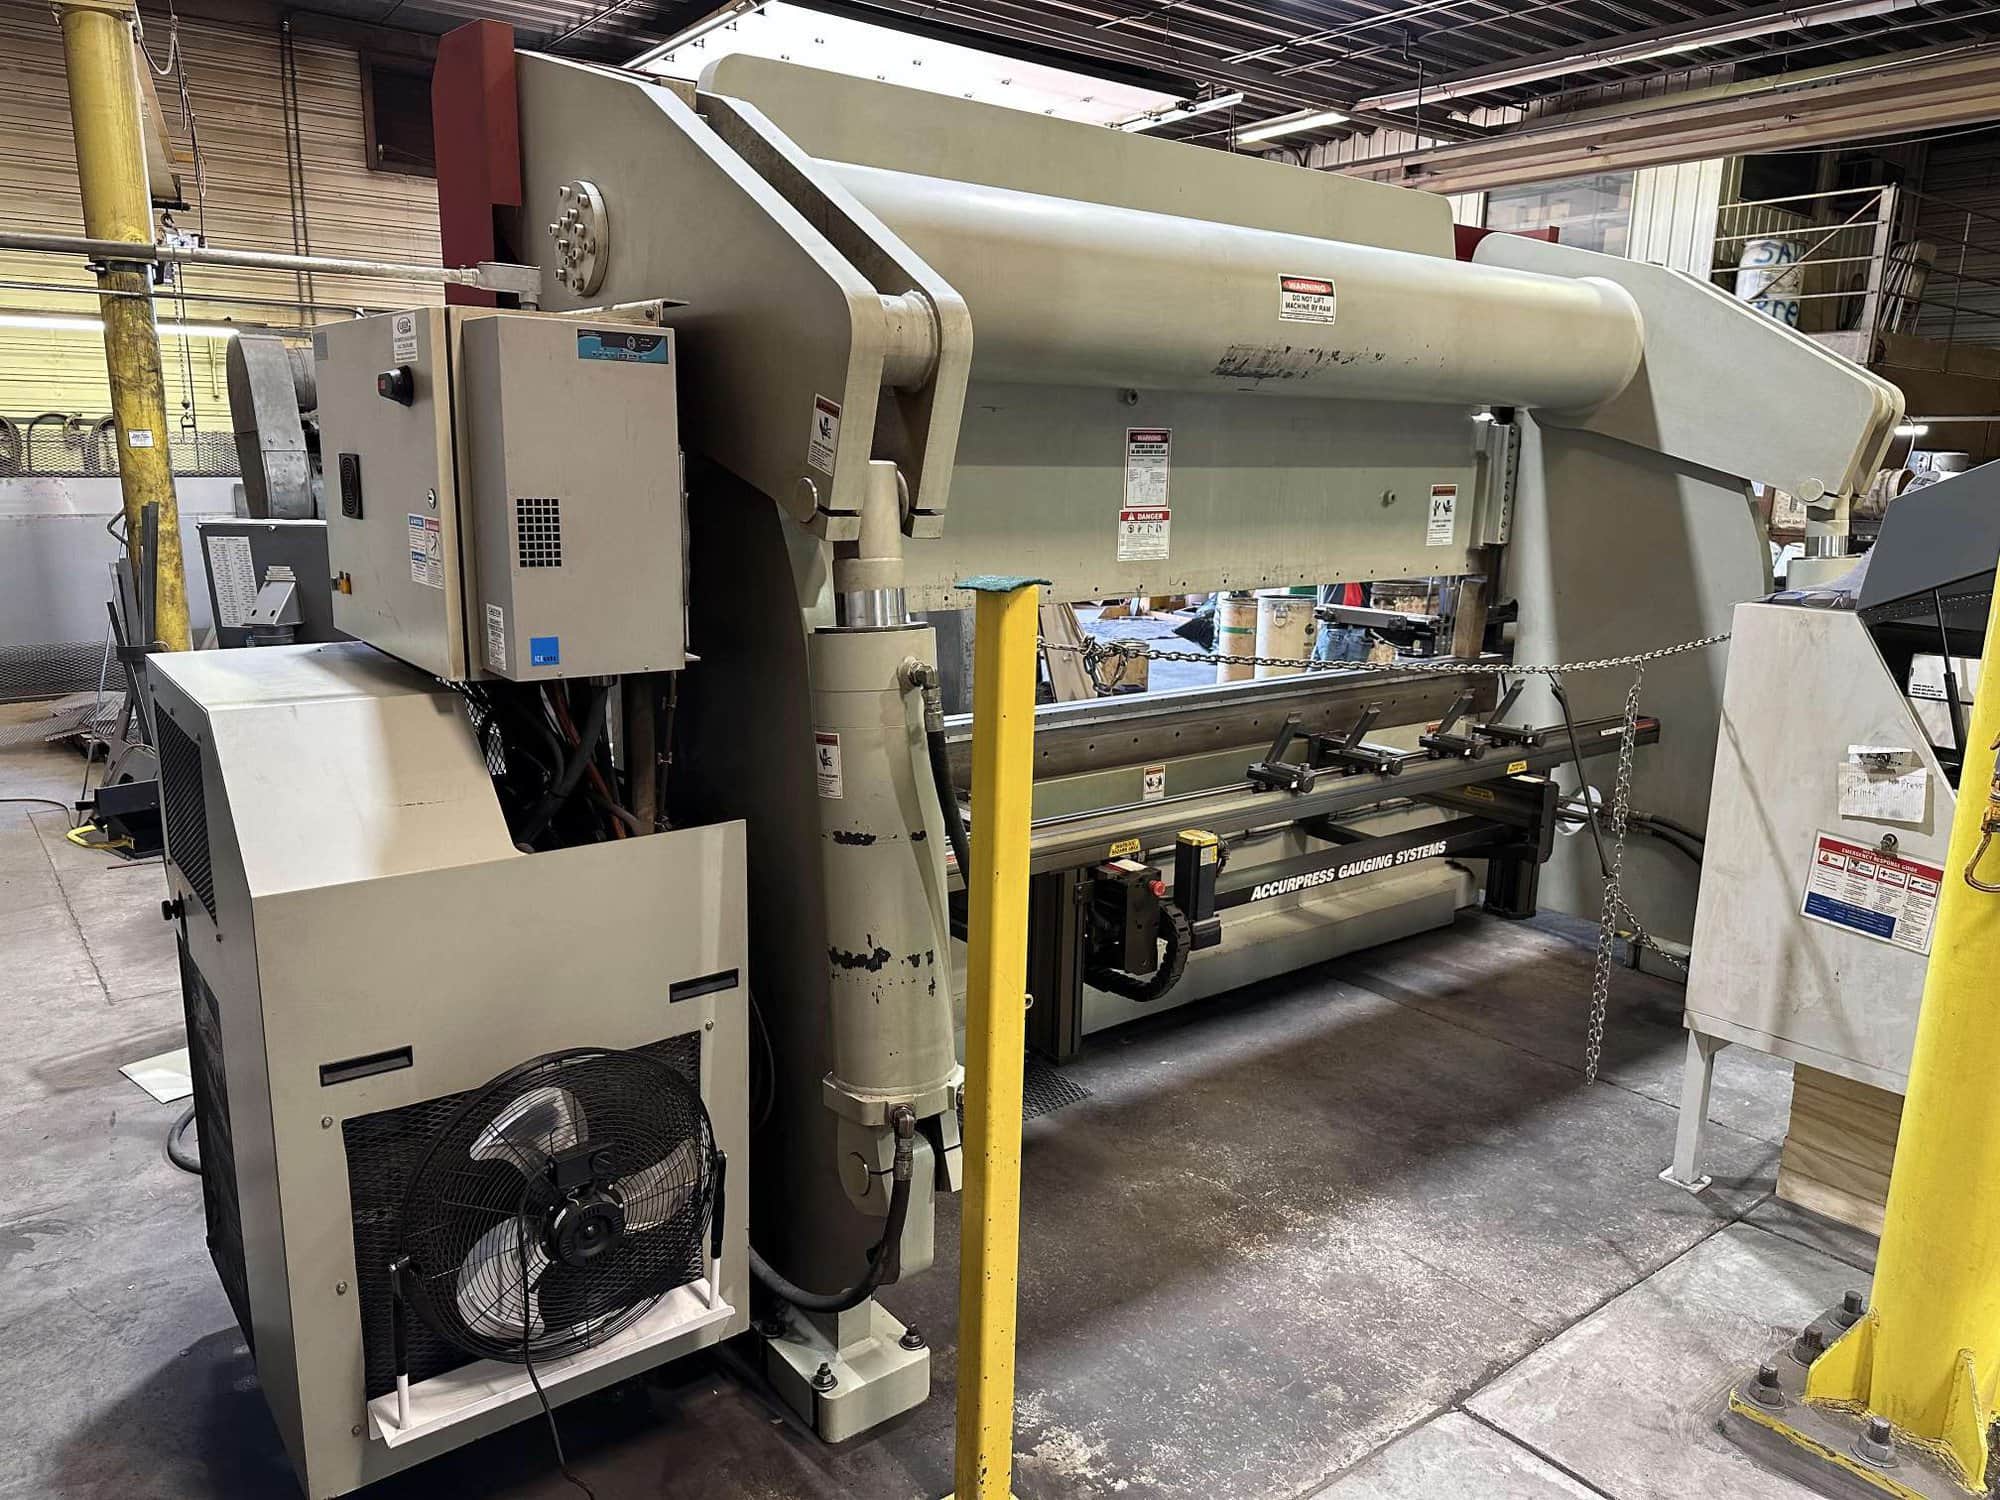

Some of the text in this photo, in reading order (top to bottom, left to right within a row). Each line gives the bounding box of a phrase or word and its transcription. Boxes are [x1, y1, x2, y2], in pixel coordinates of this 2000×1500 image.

[1288, 281, 1326, 293] WARNING
[1285, 301, 1309, 310] MACHINE
[1311, 303, 1319, 312] BY
[1841, 847, 1873, 861] EMERGENCY
[1873, 856, 1901, 869] RESPONSE
[1251, 840, 1448, 901] ACCURPRESS GAUGING SYSTEMS
